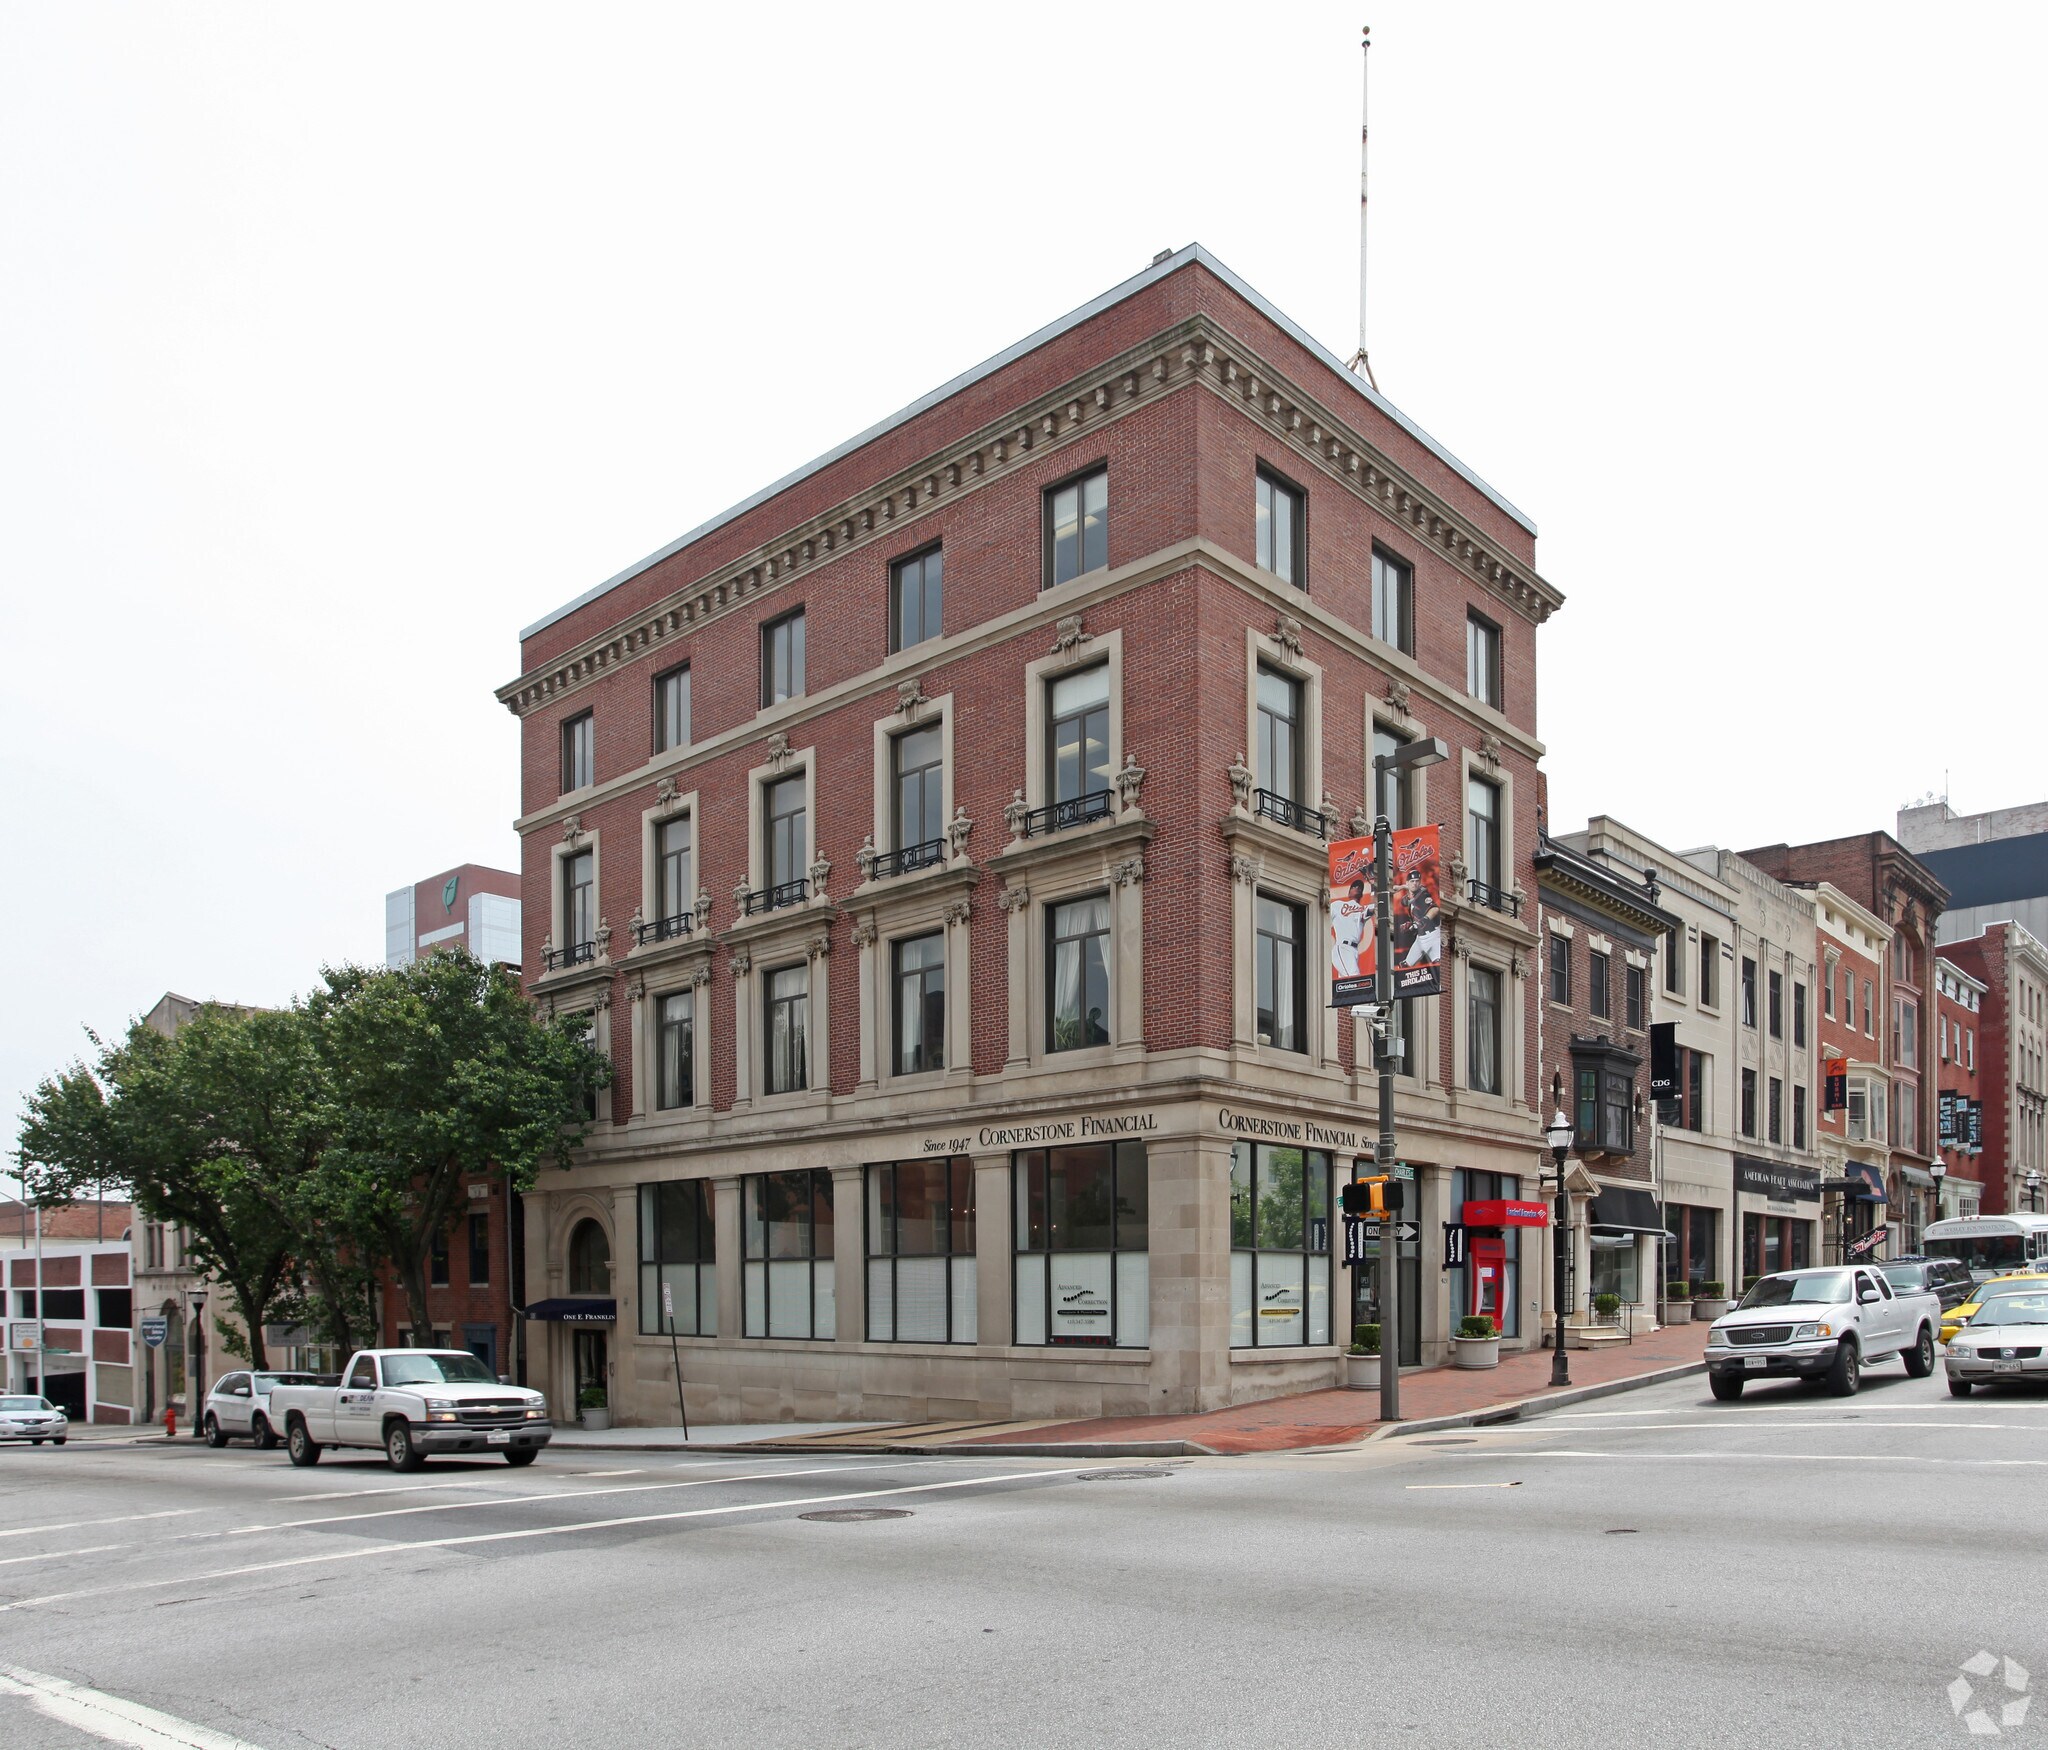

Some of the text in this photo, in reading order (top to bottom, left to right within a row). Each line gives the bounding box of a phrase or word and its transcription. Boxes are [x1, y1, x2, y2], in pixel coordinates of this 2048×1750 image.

[1397, 845, 1434, 872] Orioles
[1651, 1079, 1670, 1087] CDG
[923, 1114, 1157, 1153] Since 1947 CORNERSTONE FINANCIAL
[1219, 1108, 1301, 1139] CORNERSTONE
[1305, 1122, 1358, 1147] FINANCIAL
[1361, 1136, 1378, 1149] Sinc
[1395, 1167, 1411, 1177] CHARLES
[1744, 1170, 1814, 1190] AMERICAN HEART ASSOCIATION
